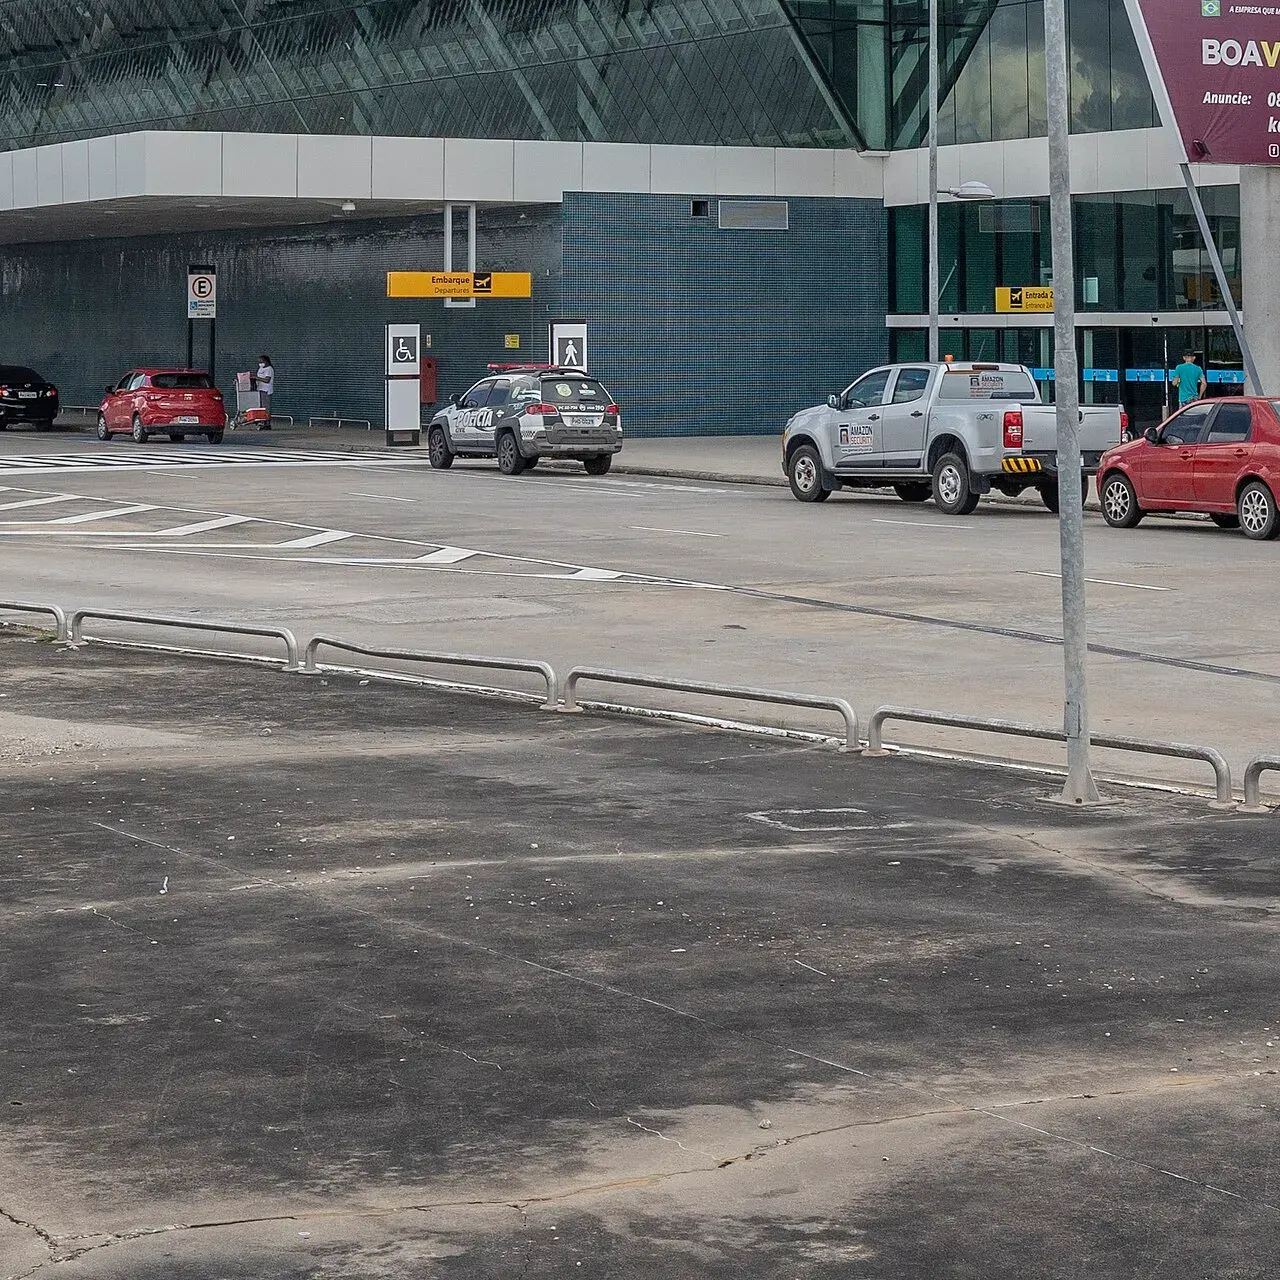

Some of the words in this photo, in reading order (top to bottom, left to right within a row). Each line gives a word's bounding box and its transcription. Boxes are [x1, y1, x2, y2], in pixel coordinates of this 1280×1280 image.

[1235, 6, 1262, 14] EMPRESA
[1262, 7, 1275, 15] QUE
[1203, 91, 1252, 105] Anuncie:
[431, 276, 470, 285] Embarque
[198, 280, 207, 294] E
[434, 287, 470, 295] Departures
[1025, 291, 1048, 299] Entrada
[850, 425, 873, 436] AMAZON
